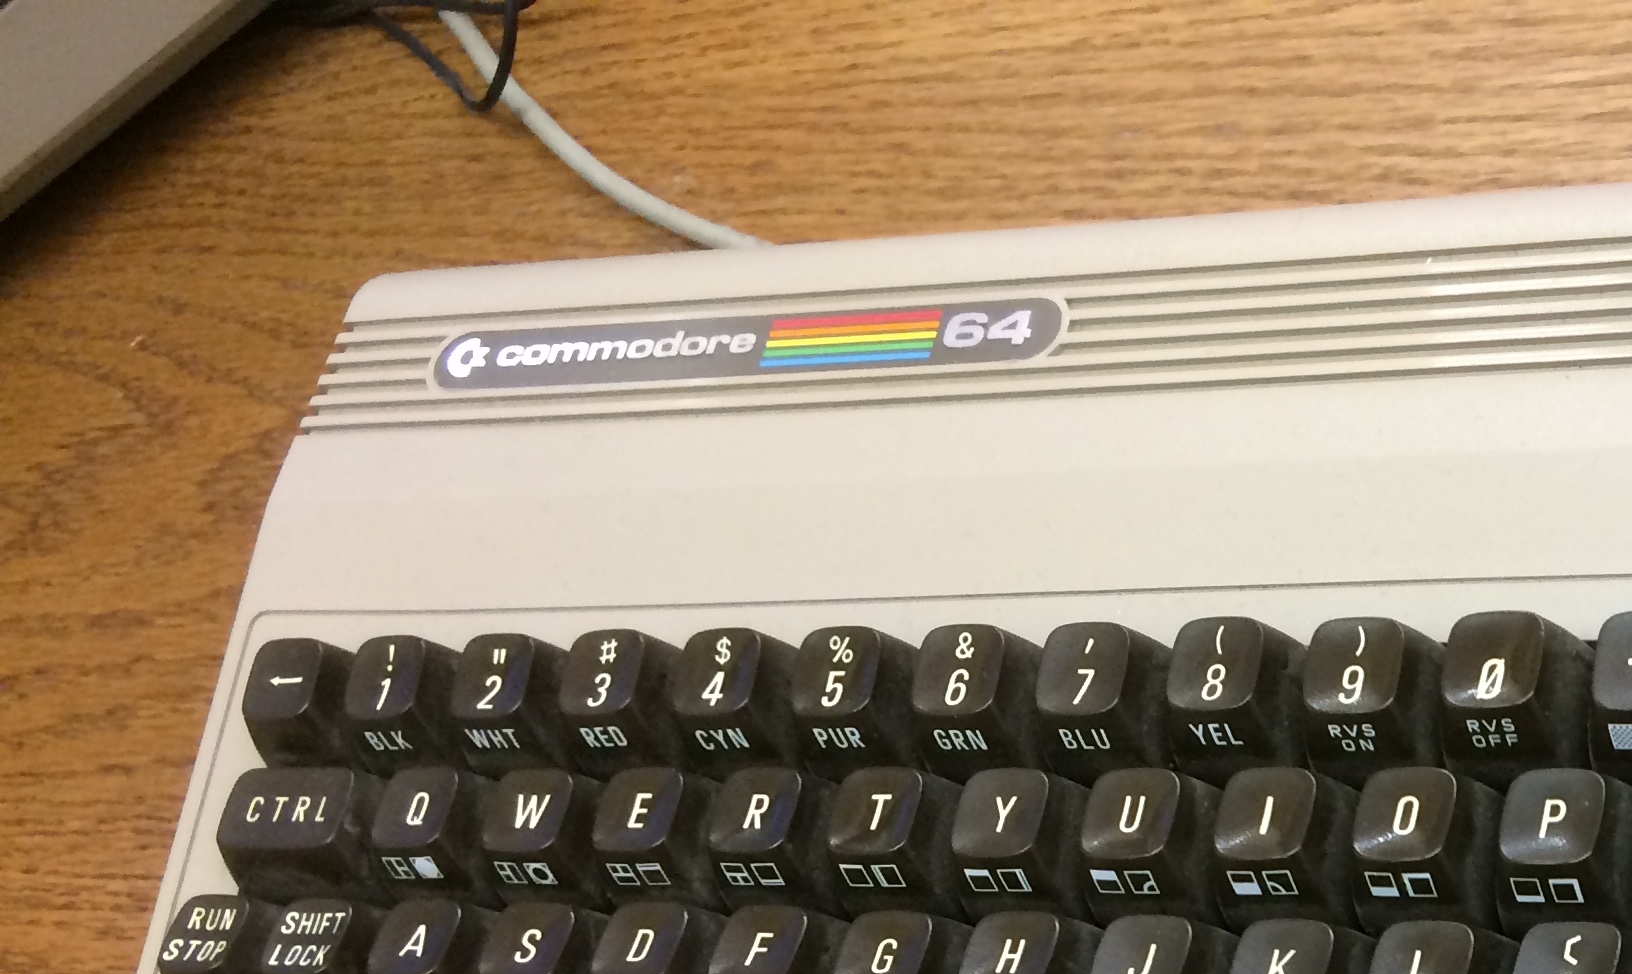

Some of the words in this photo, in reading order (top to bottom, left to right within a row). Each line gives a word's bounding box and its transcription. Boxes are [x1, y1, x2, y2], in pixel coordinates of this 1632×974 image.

[495, 330, 757, 367] commodore
[942, 309, 1032, 348] 64
[599, 638, 618, 665] #
[714, 636, 732, 665] $
[829, 635, 854, 664] %
[955, 631, 975, 659] &
[1215, 625, 1225, 655] (
[1355, 625, 1366, 657] )
[376, 677, 392, 711] 1
[476, 675, 502, 710] 2
[586, 672, 612, 708] 3
[701, 671, 725, 707] 4
[820, 670, 846, 708] 5
[944, 668, 970, 706] 6
[1072, 668, 1095, 705] 7
[1200, 663, 1226, 701] 8
[1337, 665, 1365, 705] 9
[364, 730, 413, 751] BLK
[464, 728, 520, 749] WHT
[579, 725, 628, 748] RED
[694, 727, 750, 751] CYN
[812, 727, 865, 749] PUR
[933, 729, 988, 751] GRN
[1058, 728, 1111, 750] BLU
[1188, 723, 1244, 746] YEL
[1327, 723, 1376, 738] RVS
[1465, 718, 1515, 733] RVS
[1471, 733, 1518, 748] OFF
[1341, 738, 1375, 752] ON
[245, 796, 327, 823] CTRL
[405, 791, 430, 826] Q
[514, 793, 551, 829] W
[627, 792, 653, 829] E
[742, 793, 770, 830] R
[869, 793, 893, 831] T
[995, 795, 1018, 833] Y
[1118, 795, 1146, 834] U
[1392, 795, 1420, 837] O
[1538, 799, 1567, 840] P
[187, 906, 237, 931] RUN
[280, 911, 346, 935] SHIFT
[162, 938, 227, 962] STOP
[267, 943, 330, 966] LOCK
[398, 924, 427, 957] A
[513, 928, 542, 964] S
[625, 928, 655, 962] D
[744, 932, 774, 966] F
[871, 938, 898, 974] G
[995, 938, 1026, 974] H
